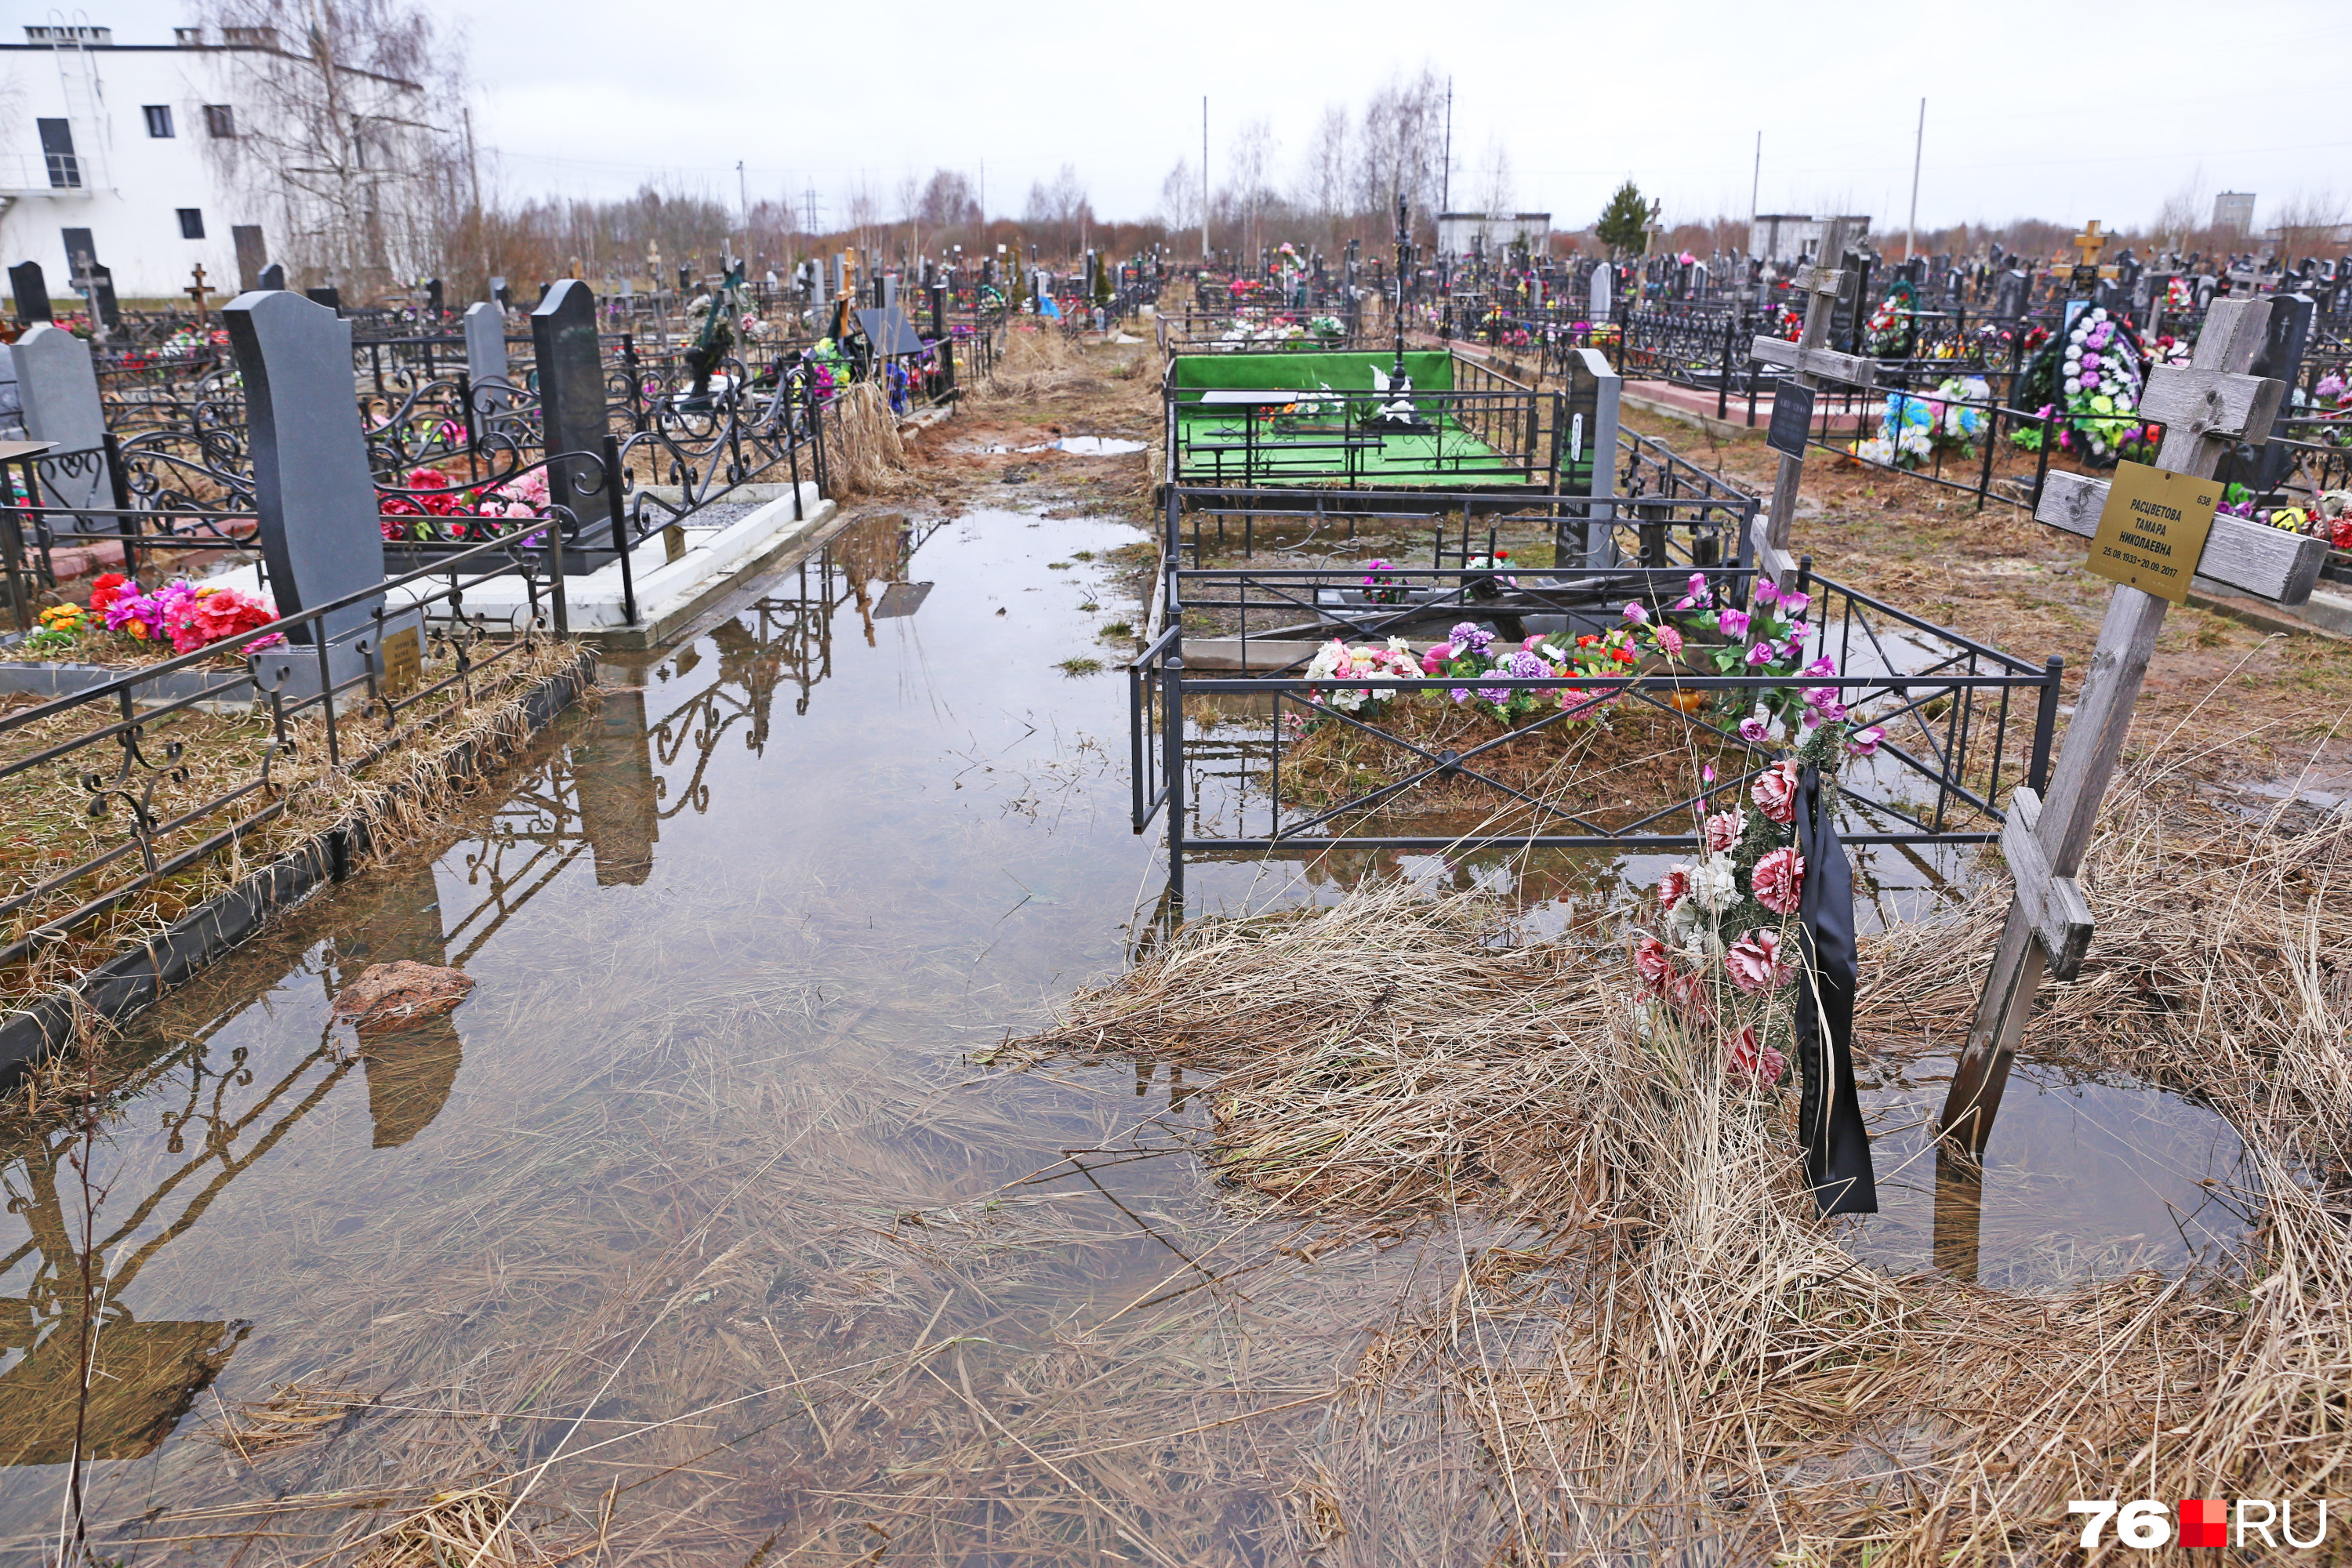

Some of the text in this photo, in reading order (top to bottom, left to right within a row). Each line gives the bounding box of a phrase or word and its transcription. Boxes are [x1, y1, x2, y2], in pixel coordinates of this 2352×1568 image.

[2130, 499, 2182, 522] РАСЦВЕТОВА
[2197, 495, 2212, 506] 638
[2135, 517, 2167, 536] ТАМАРА
[2119, 531, 2172, 557] НИКОЛАЕВНА
